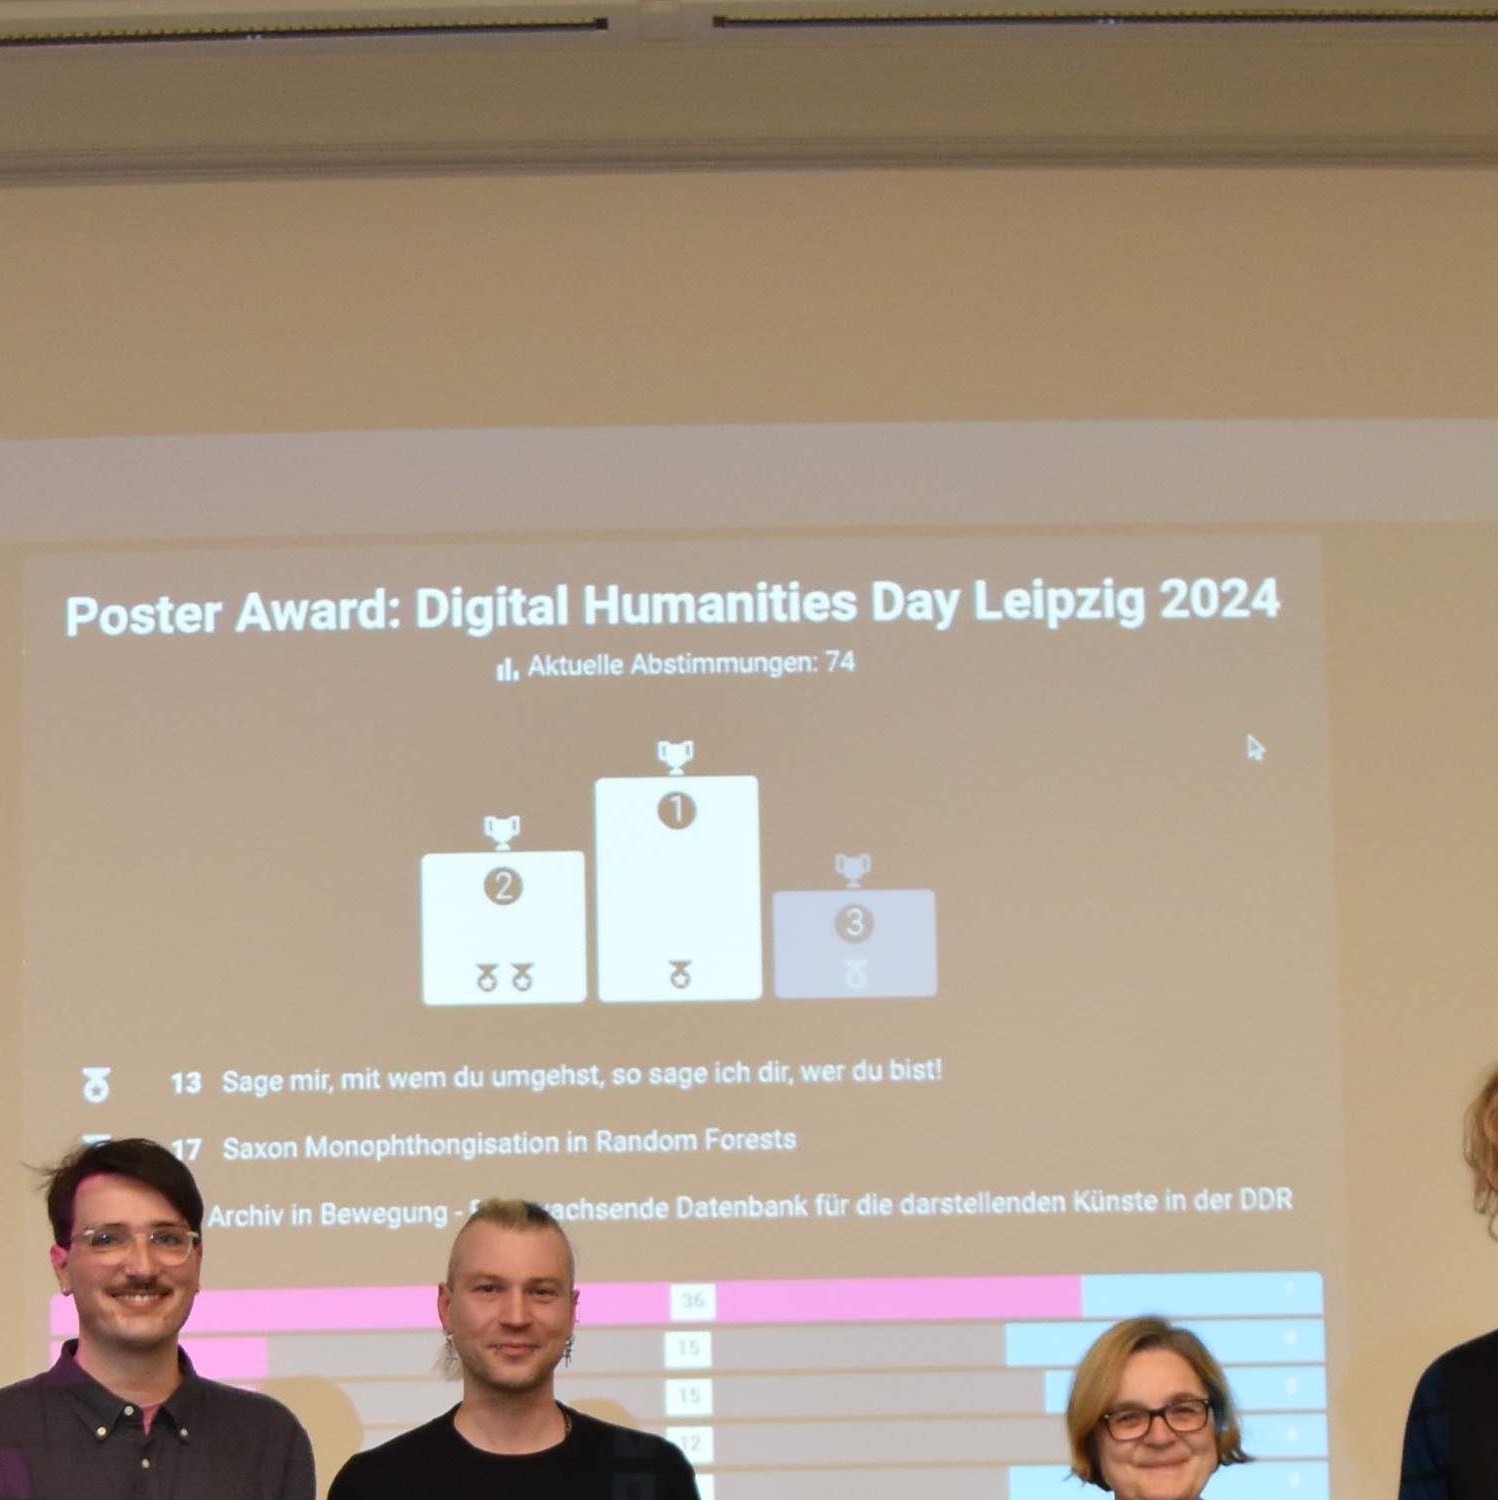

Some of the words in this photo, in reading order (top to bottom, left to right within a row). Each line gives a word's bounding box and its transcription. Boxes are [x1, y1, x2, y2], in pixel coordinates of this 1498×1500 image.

[67, 596, 223, 637] Poster
[235, 588, 400, 632] Award:
[417, 584, 568, 638] Digital
[584, 581, 858, 625] Humanities
[872, 581, 961, 631] Day
[975, 578, 1145, 630] Leipzig
[1160, 578, 1281, 619] 2024
[528, 654, 624, 676] Aktuelle
[630, 653, 817, 678] Abstimmungen:
[826, 650, 856, 672] 74
[493, 871, 514, 901] 2
[844, 908, 864, 938] 3
[172, 1072, 202, 1094] 13
[223, 1070, 284, 1098] Sage
[290, 1069, 334, 1094] mir,
[341, 1068, 380, 1090] mit
[388, 1071, 446, 1089] wem
[453, 1066, 484, 1089] du
[491, 1064, 605, 1093] umgehst,
[612, 1067, 642, 1086] so
[649, 1066, 708, 1090] sage
[714, 1061, 751, 1084] ich
[758, 1061, 794, 1085] dir,
[800, 1065, 845, 1083] wer
[852, 1060, 883, 1082] du
[889, 1058, 942, 1082] bist!
[172, 1138, 202, 1161] 17
[223, 1137, 298, 1161] Saxon
[305, 1132, 559, 1162] Monophthongisation
[566, 1131, 588, 1153] in
[596, 1130, 698, 1153] Random
[705, 1128, 797, 1151] Forests
[207, 1204, 284, 1228] Archiv
[291, 1204, 312, 1226] in
[320, 1202, 448, 1230] Bewegung
[676, 1195, 808, 1219] Datenbank
[815, 1193, 850, 1217] für
[855, 1194, 893, 1217] die
[900, 1191, 1066, 1216] darstellenden
[1073, 1190, 1159, 1213] Künste
[1165, 1190, 1187, 1211] in
[1193, 1189, 1233, 1212] der
[1240, 1187, 1293, 1211] DDR
[682, 1291, 705, 1308] 36
[678, 1340, 700, 1356] 15
[679, 1387, 701, 1403] 15
[680, 1435, 701, 1451] 12
